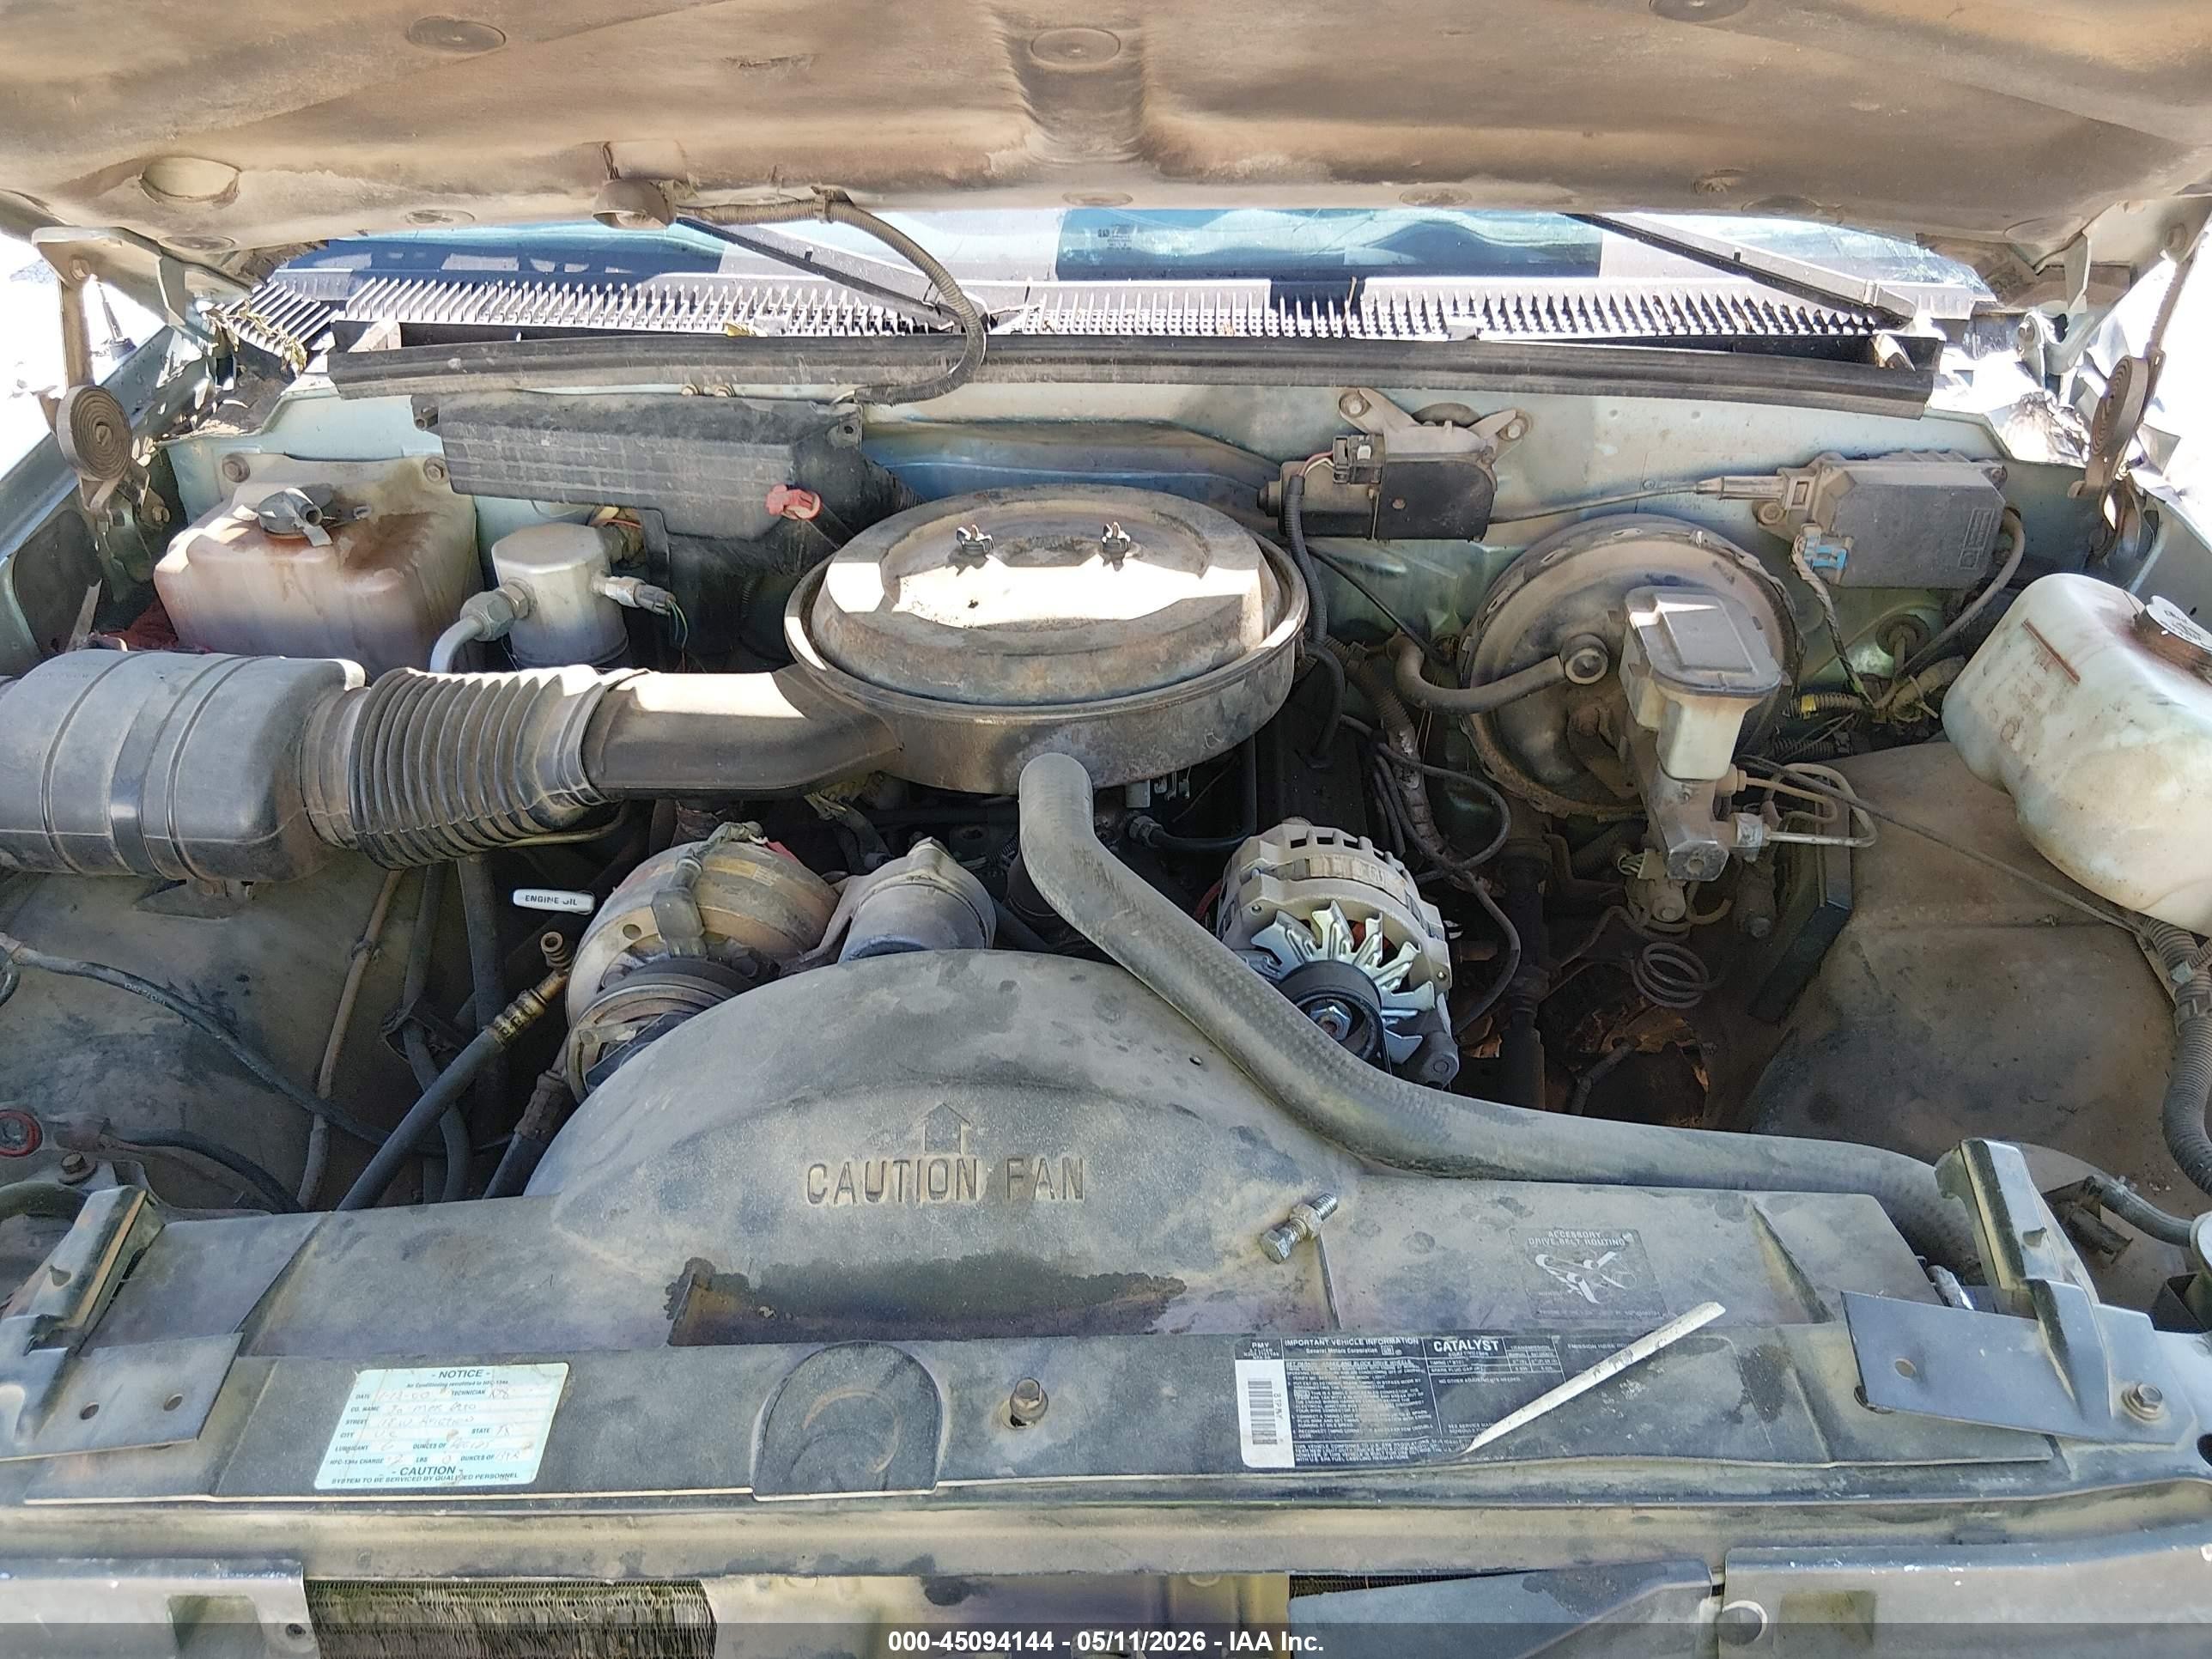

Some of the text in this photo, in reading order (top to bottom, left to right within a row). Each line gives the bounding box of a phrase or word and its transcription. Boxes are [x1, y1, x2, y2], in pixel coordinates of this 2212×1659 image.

[525, 895, 560, 904] ENGINE
[806, 1158, 1085, 1204] CAUTION FAN
[1528, 1237, 1626, 1246] DRIVE BELT ROUTING
[1331, 1338, 1364, 1346] VEHICLE
[1366, 1336, 1419, 1346] INFORMATION
[1433, 1339, 1499, 1352] CATALYST
[439, 1369, 484, 1378] NOTICE
[399, 1466, 456, 1476] CAUTION
